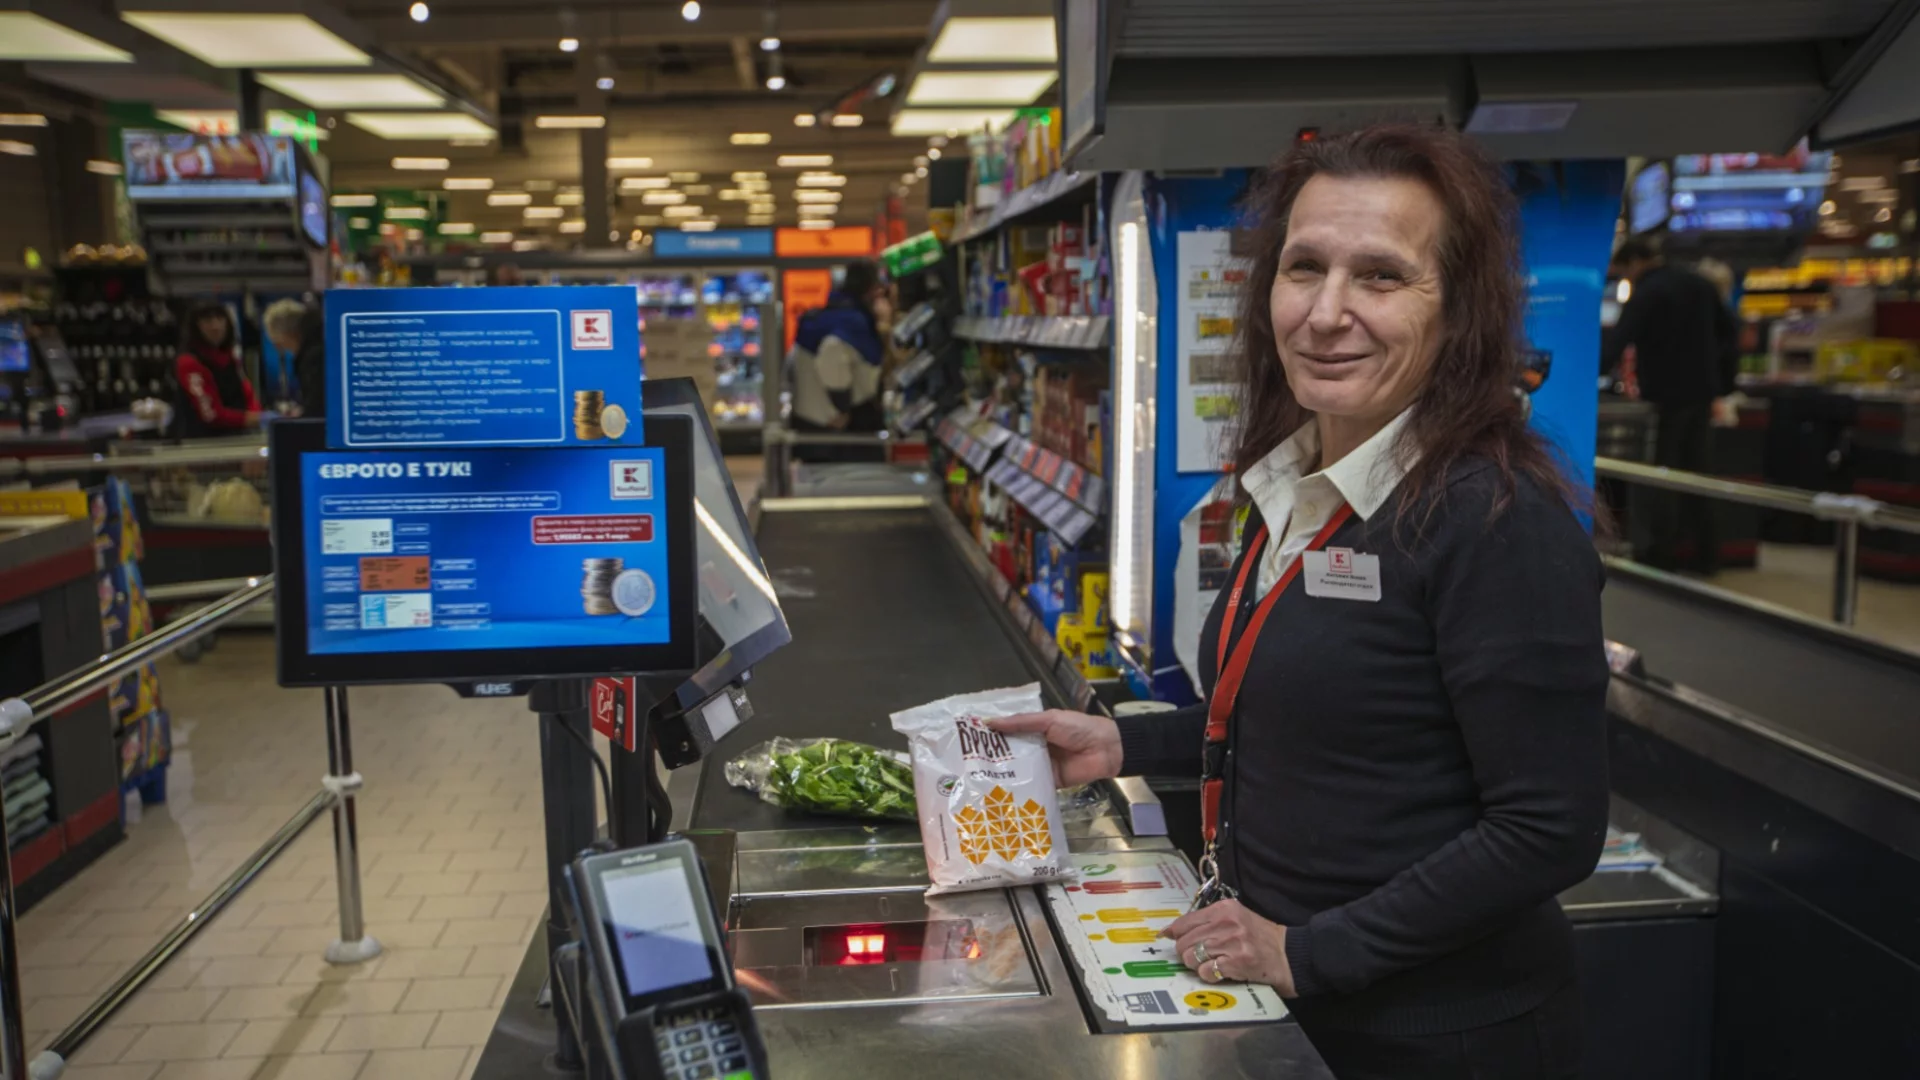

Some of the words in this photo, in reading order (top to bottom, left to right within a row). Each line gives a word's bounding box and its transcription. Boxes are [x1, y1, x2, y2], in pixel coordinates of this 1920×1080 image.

[408, 462, 420, 477] Е
[424, 461, 472, 477] ТУК!
[1033, 866, 1049, 877] 200
